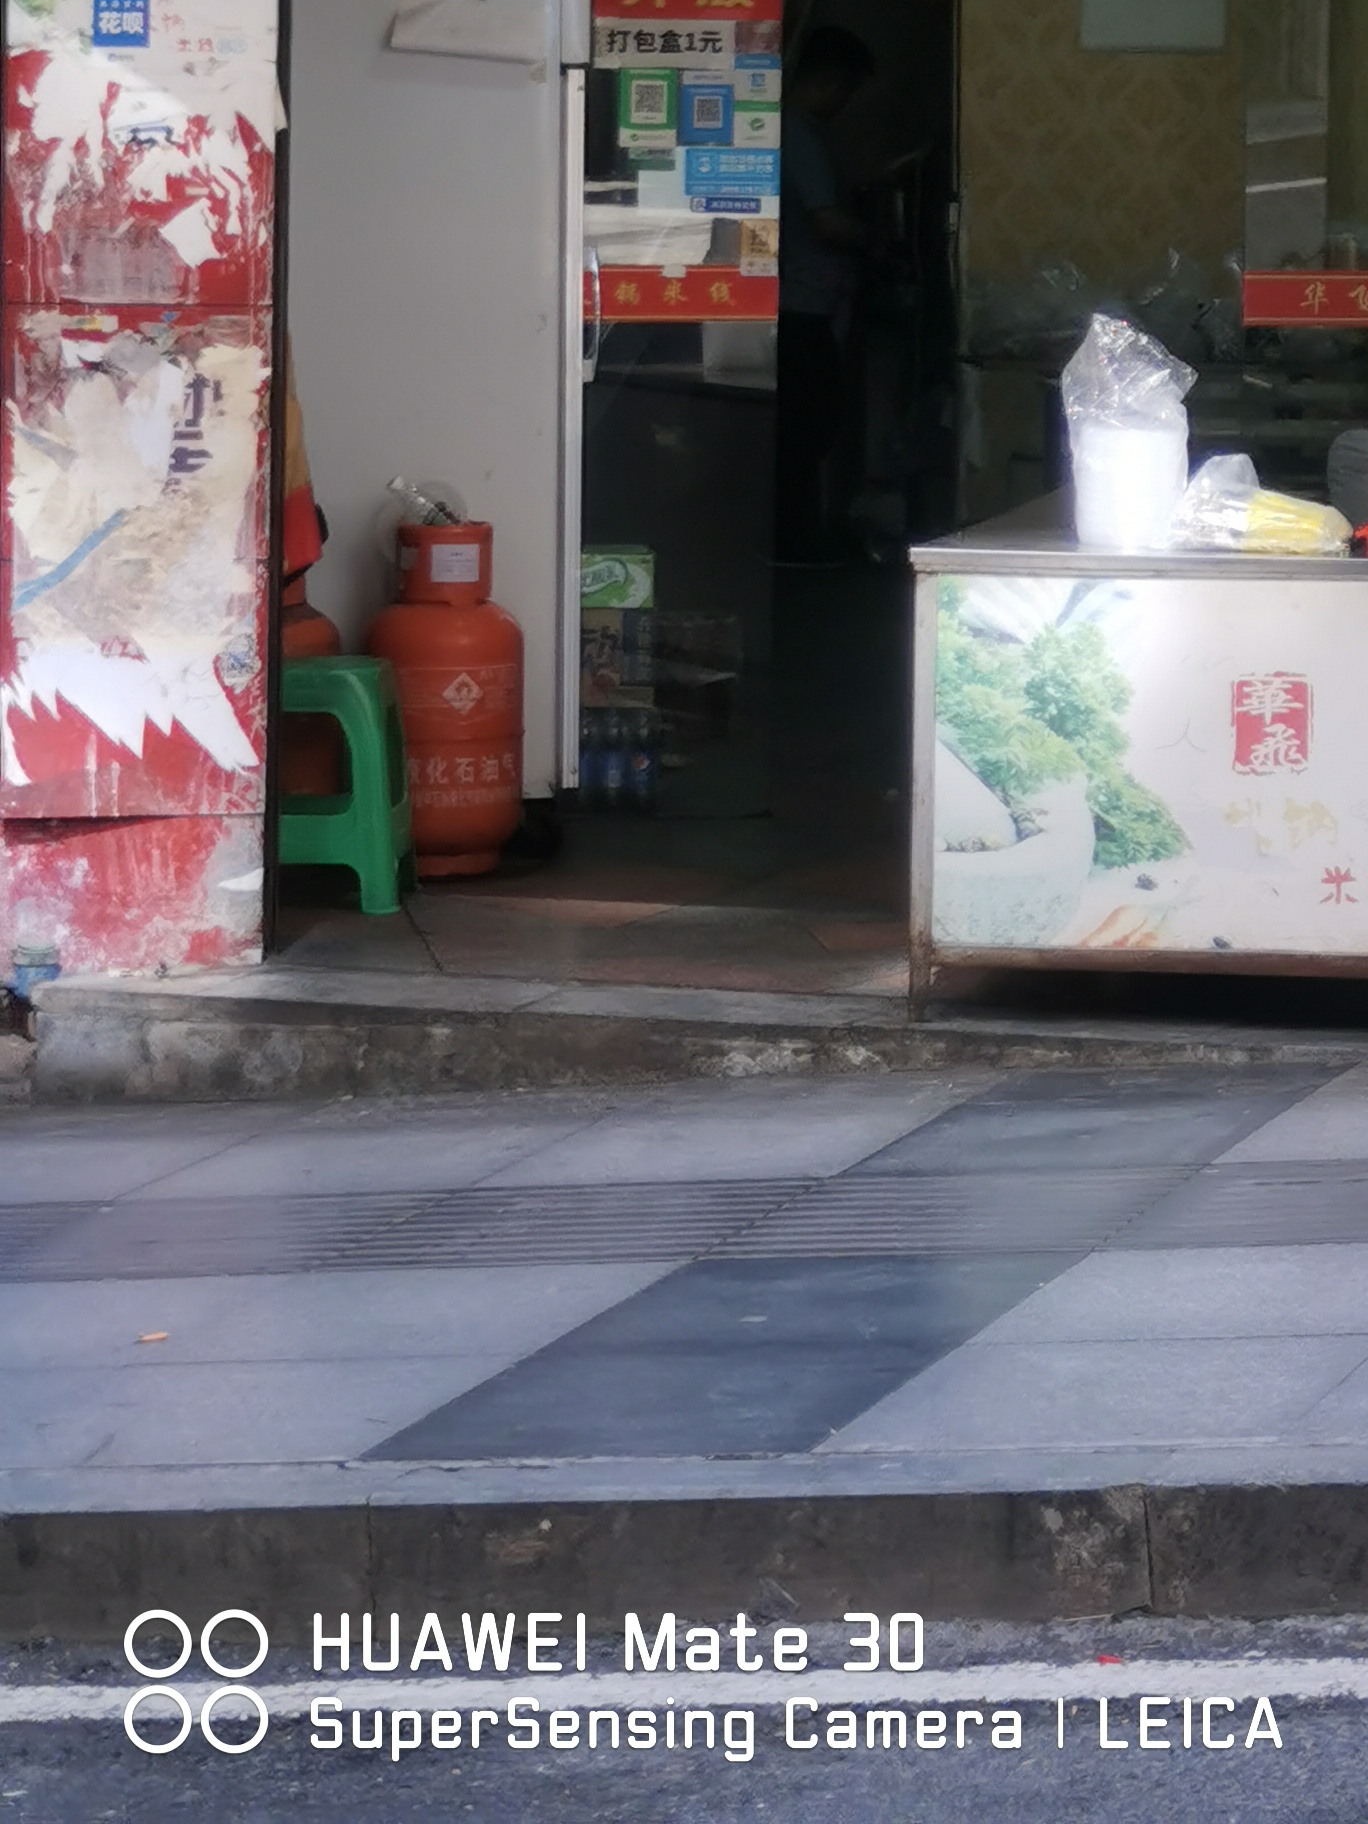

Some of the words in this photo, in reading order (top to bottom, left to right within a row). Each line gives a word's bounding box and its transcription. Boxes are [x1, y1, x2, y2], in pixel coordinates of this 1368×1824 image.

[99, 11, 144, 34] 花呗
[607, 29, 723, 54] 打包盒1元
